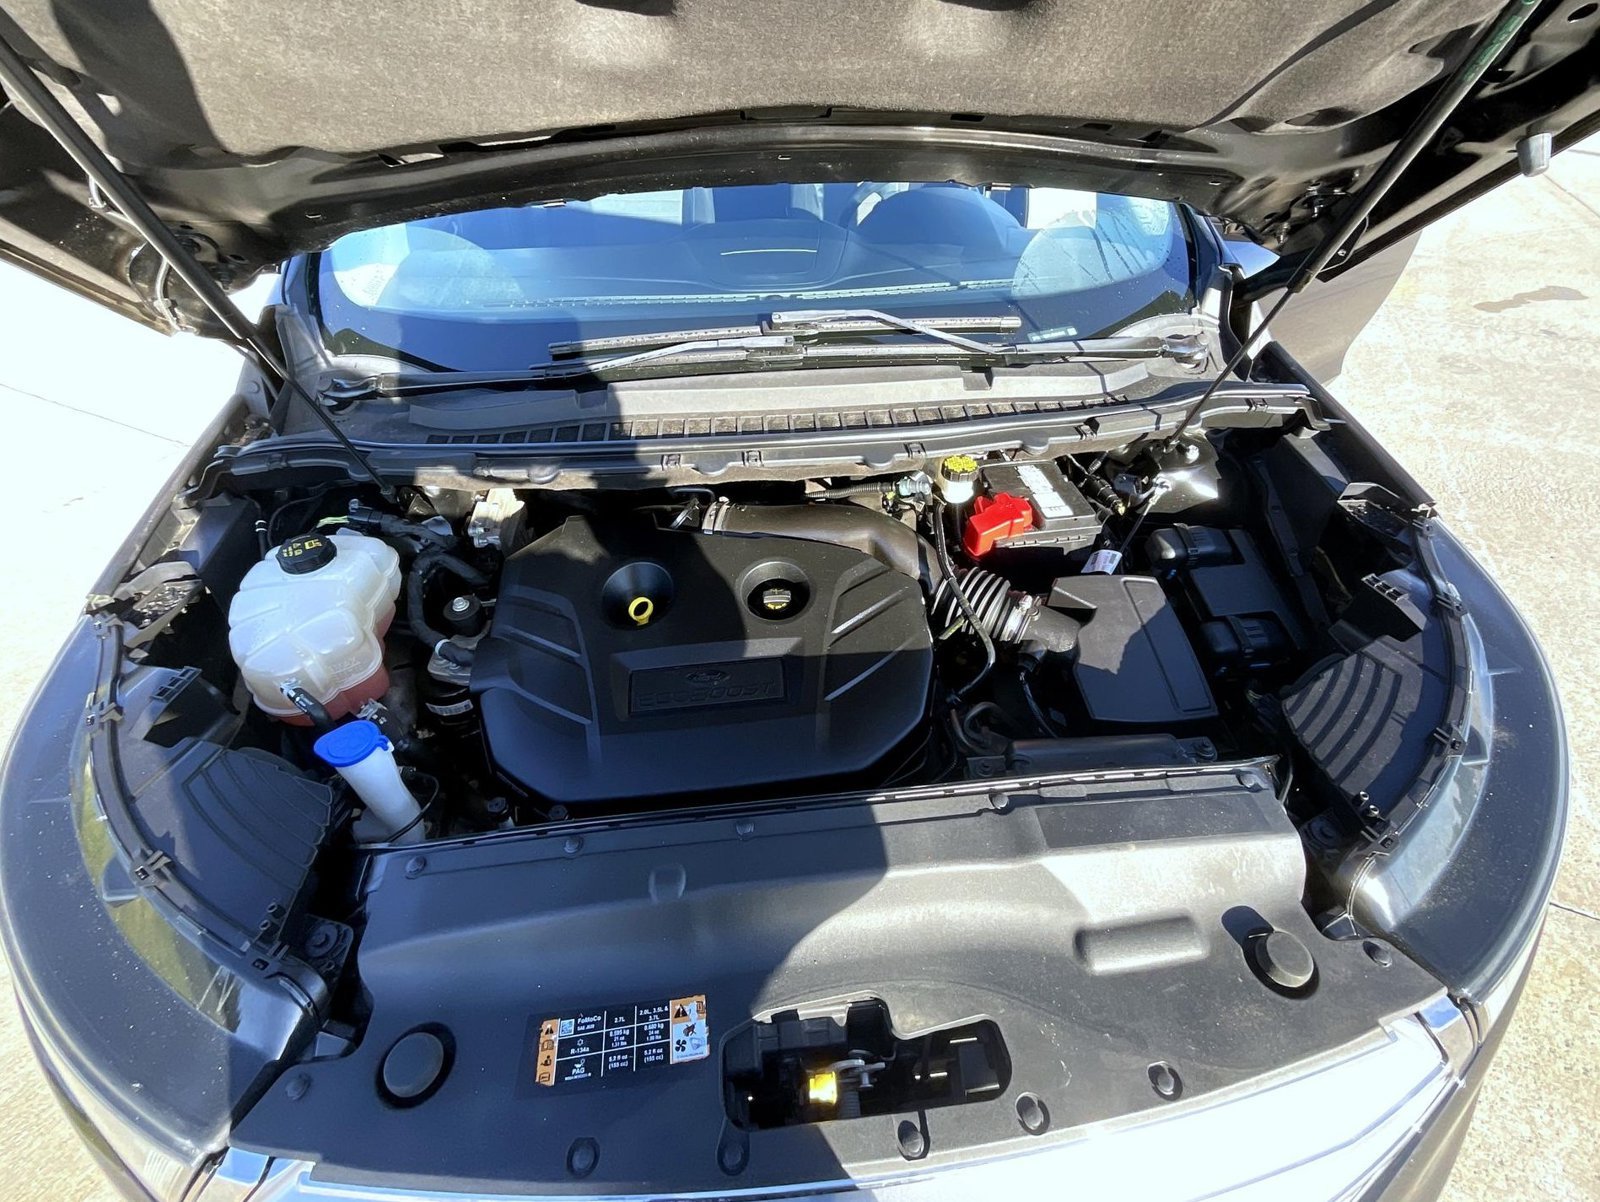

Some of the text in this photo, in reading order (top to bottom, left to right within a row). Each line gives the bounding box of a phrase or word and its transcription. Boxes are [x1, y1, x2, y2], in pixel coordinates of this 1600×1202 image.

[577, 1015, 602, 1025] FoMoCo
[570, 1046, 590, 1055] R-134a
[571, 1066, 586, 1076] PAG
